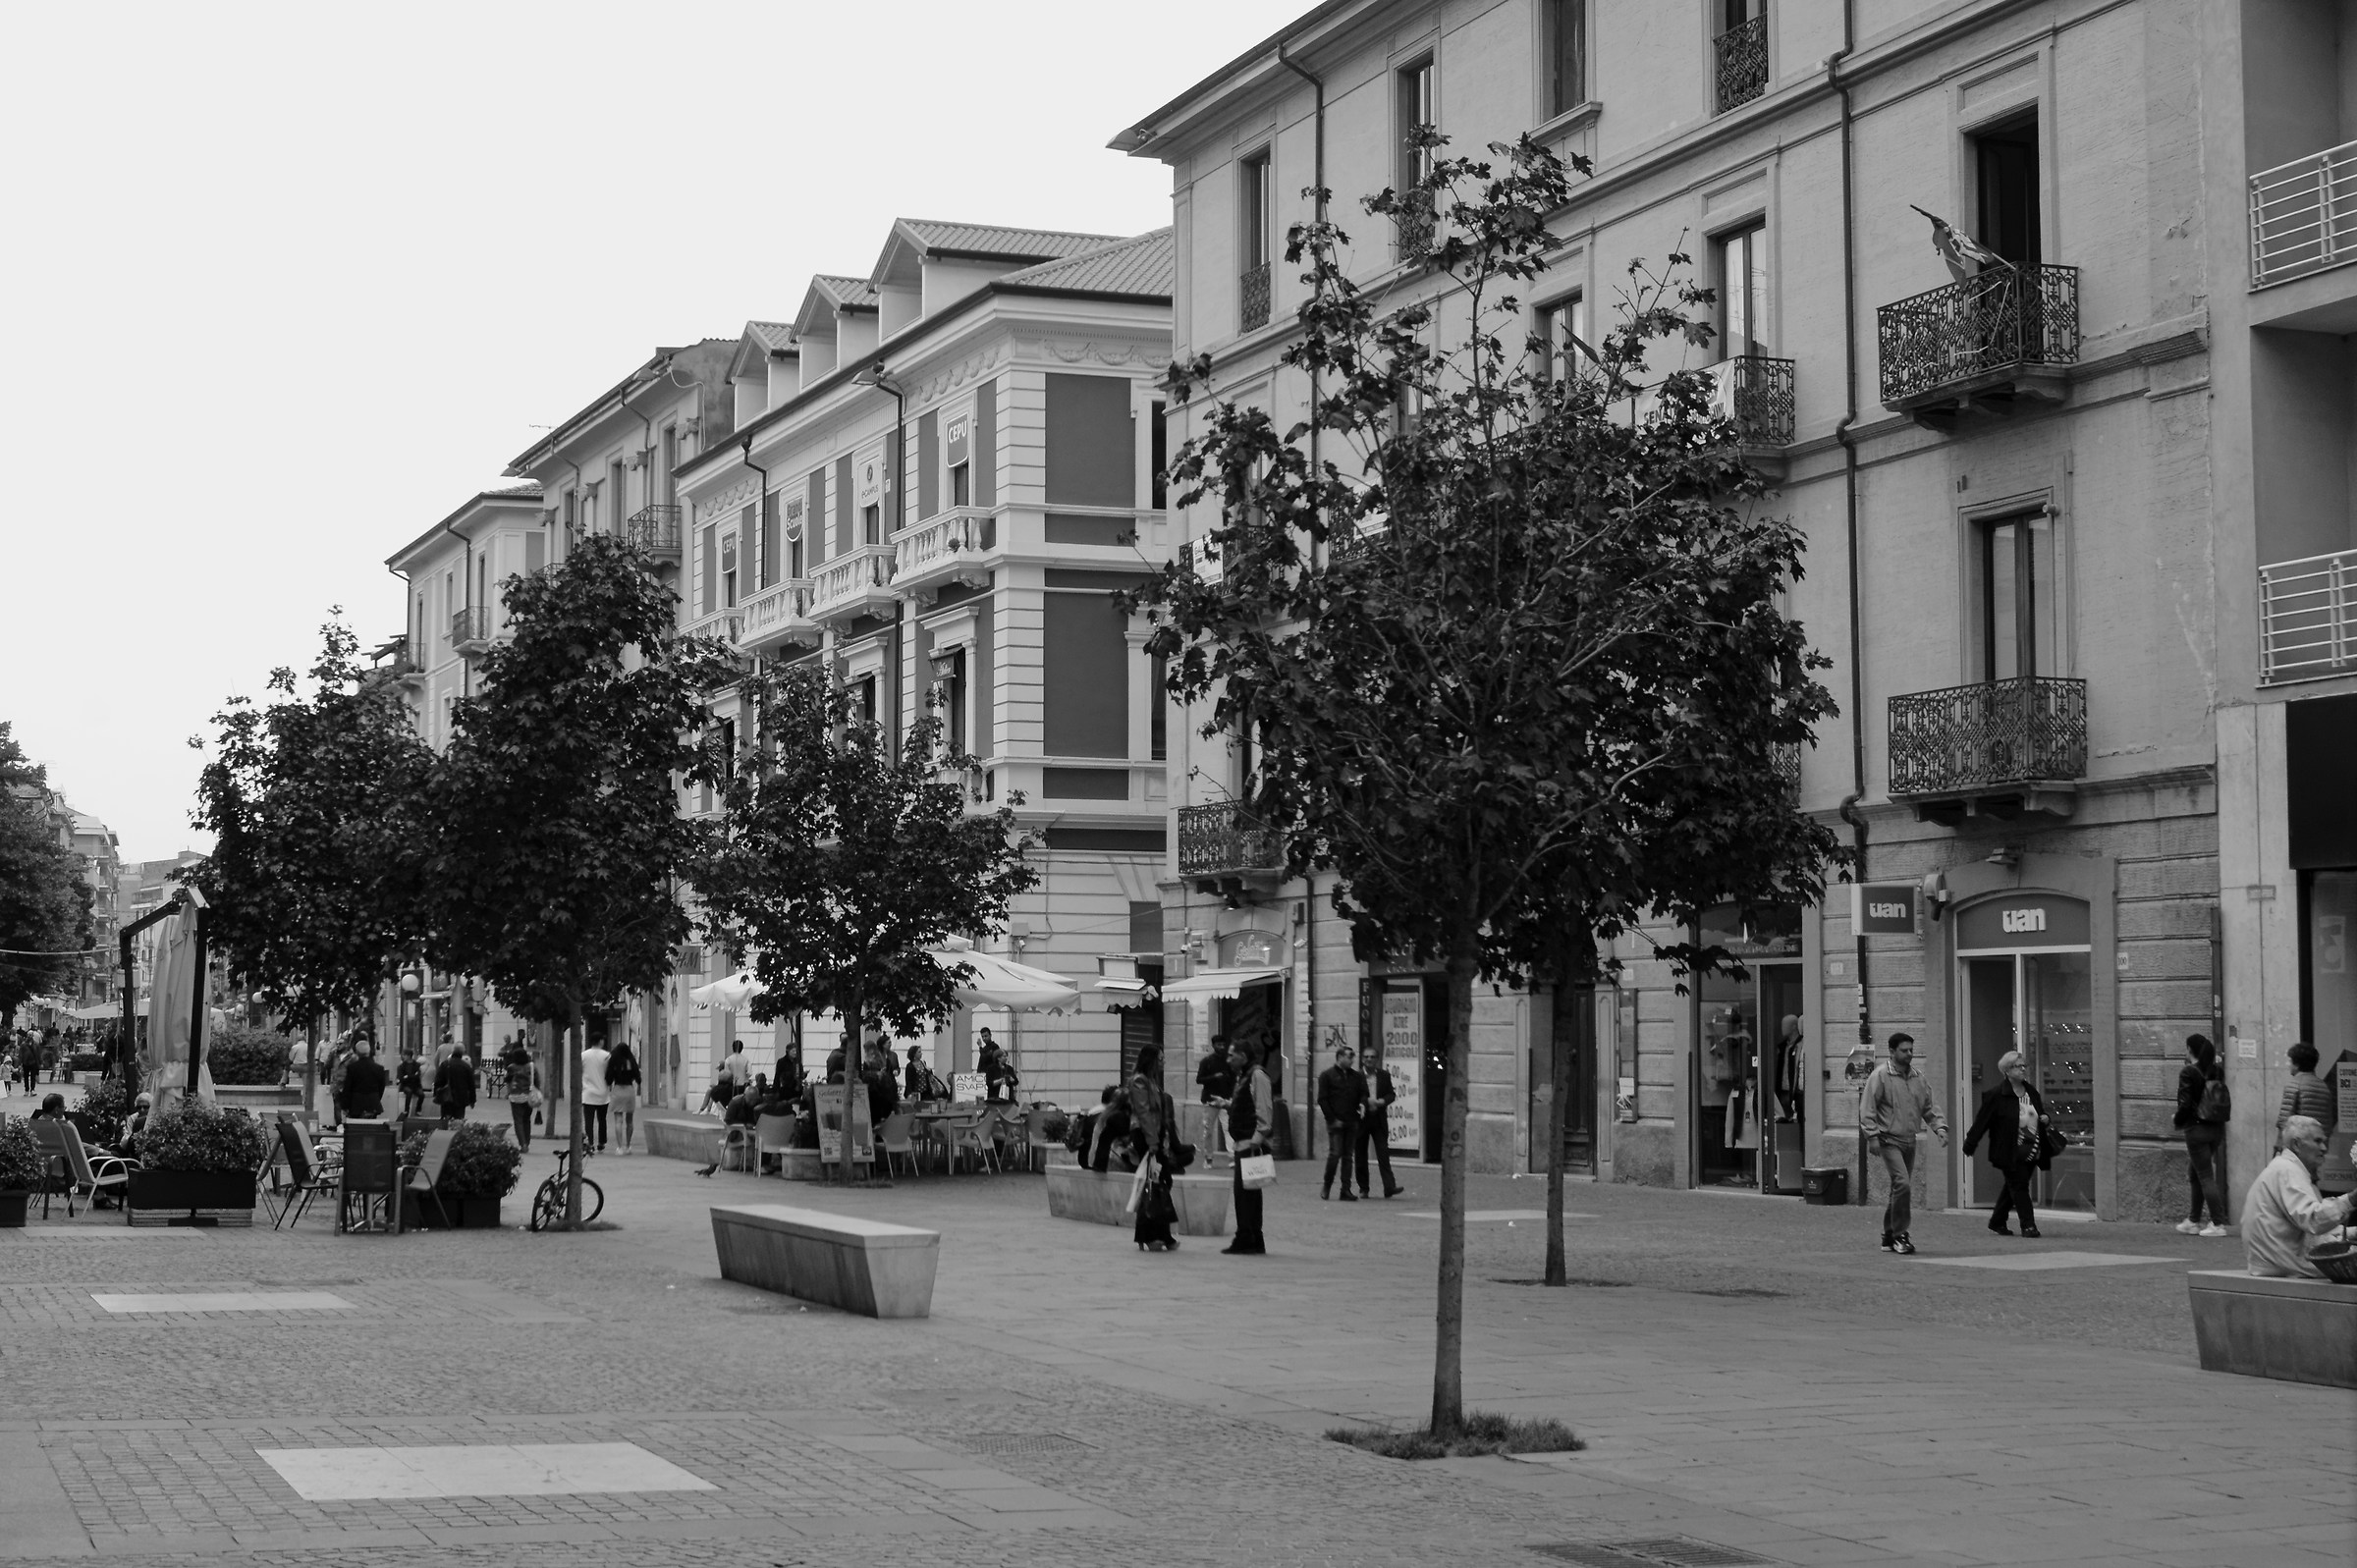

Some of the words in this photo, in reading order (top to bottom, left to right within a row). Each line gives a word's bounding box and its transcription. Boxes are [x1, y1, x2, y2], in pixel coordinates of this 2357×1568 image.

[949, 420, 967, 444] CEPU
[1386, 1032, 1418, 1046] 2000
[1385, 1047, 1418, 1058] ARTICOLI
